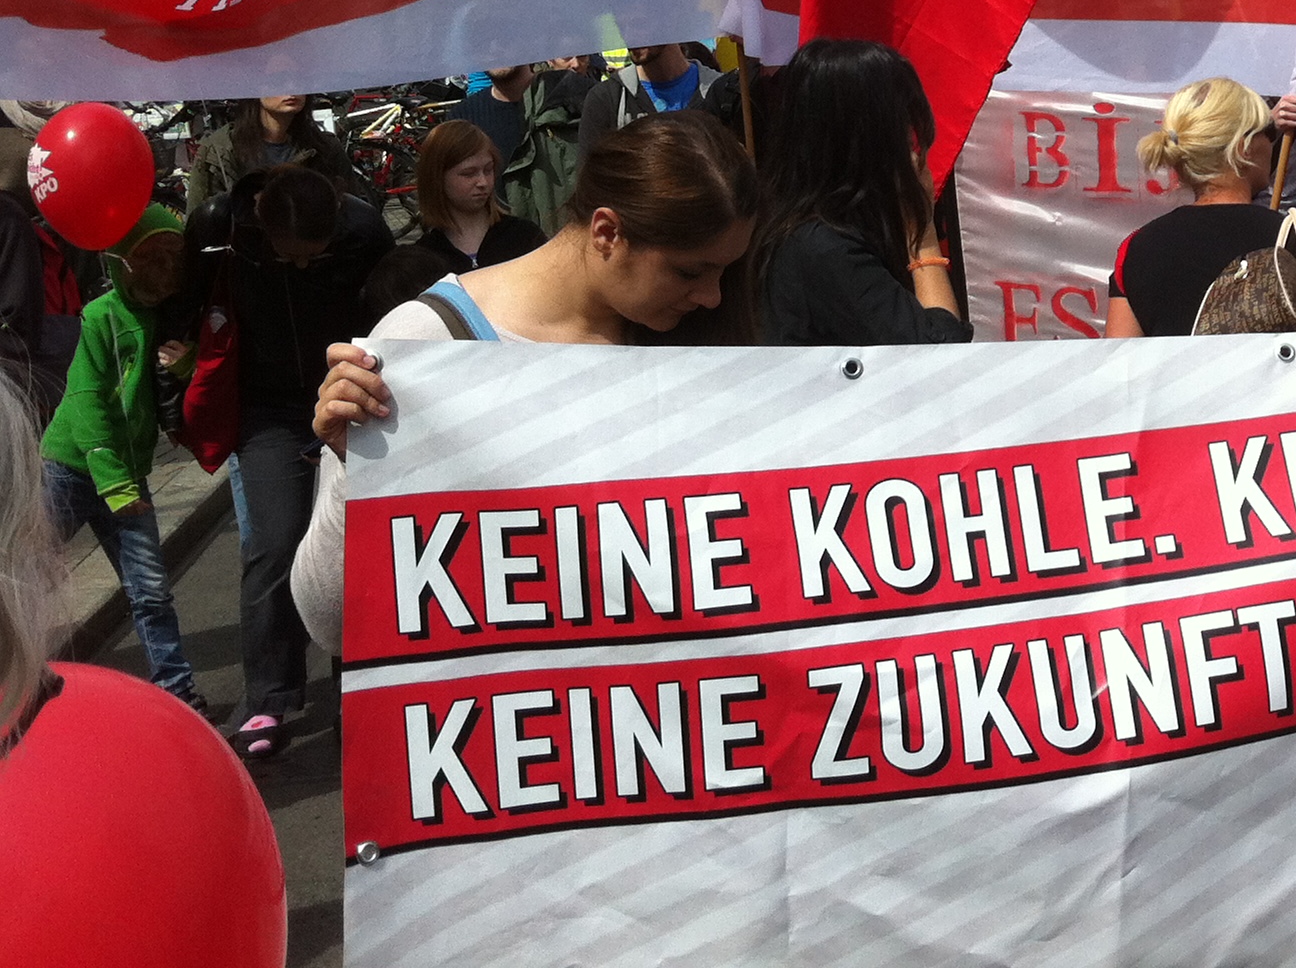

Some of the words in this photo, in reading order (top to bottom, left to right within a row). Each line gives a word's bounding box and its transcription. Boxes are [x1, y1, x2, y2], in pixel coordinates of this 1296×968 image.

[390, 493, 757, 635] KEINE
[787, 452, 1180, 600] KOHLE.
[403, 675, 769, 821] KEINE
